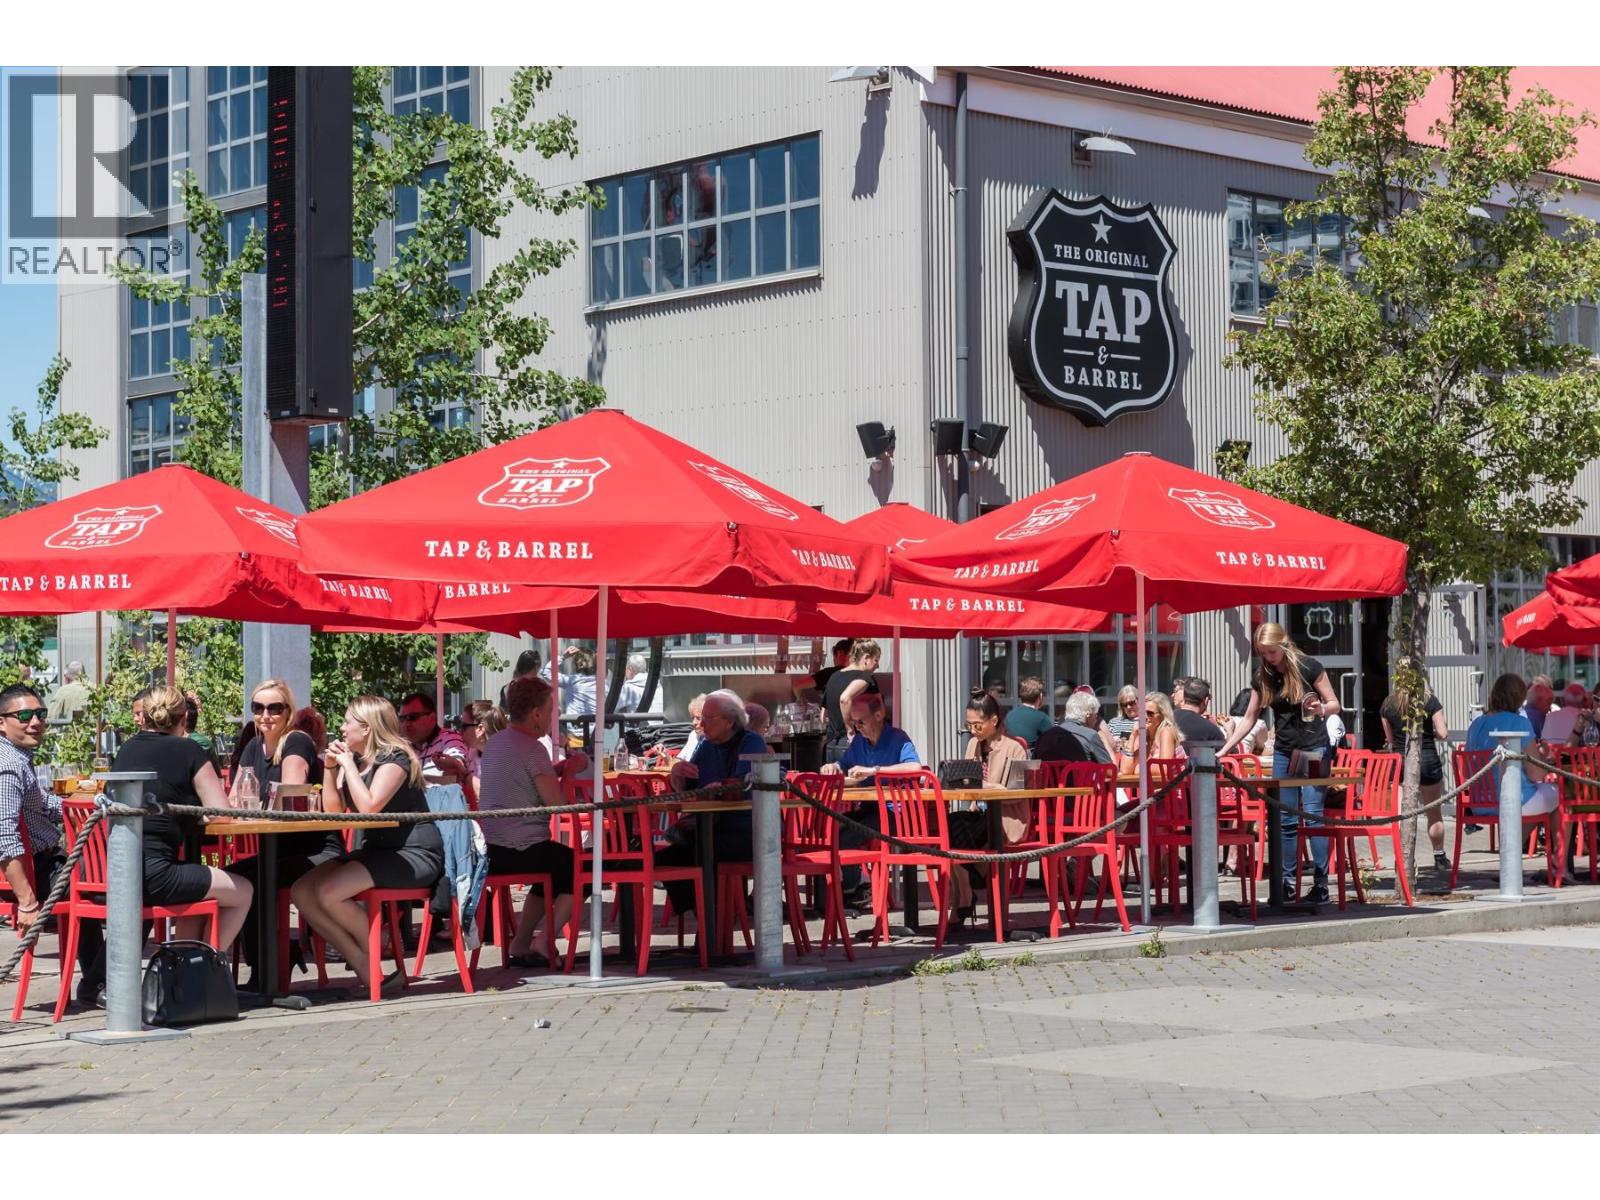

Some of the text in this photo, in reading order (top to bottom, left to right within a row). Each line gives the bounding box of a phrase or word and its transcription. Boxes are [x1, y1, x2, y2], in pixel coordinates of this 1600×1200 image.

[1054, 244, 1149, 268] THE ORIGINAL
[1055, 279, 1152, 344] TAP
[1097, 345, 1109, 365] &
[1063, 365, 1142, 391] BARREL
[508, 478, 583, 493] TAP
[1193, 503, 1250, 518] TAP
[72, 522, 137, 537] TAP
[425, 539, 593, 561] TAP & BARREL
[819, 551, 856, 570] BARREL
[953, 559, 1040, 579] TAP & BARREL
[1216, 551, 1327, 571] TAP & BARREL
[0, 574, 132, 591] TAP & BARREL
[445, 582, 511, 599] BARREL
[909, 598, 1025, 613] TAP & BARREL
